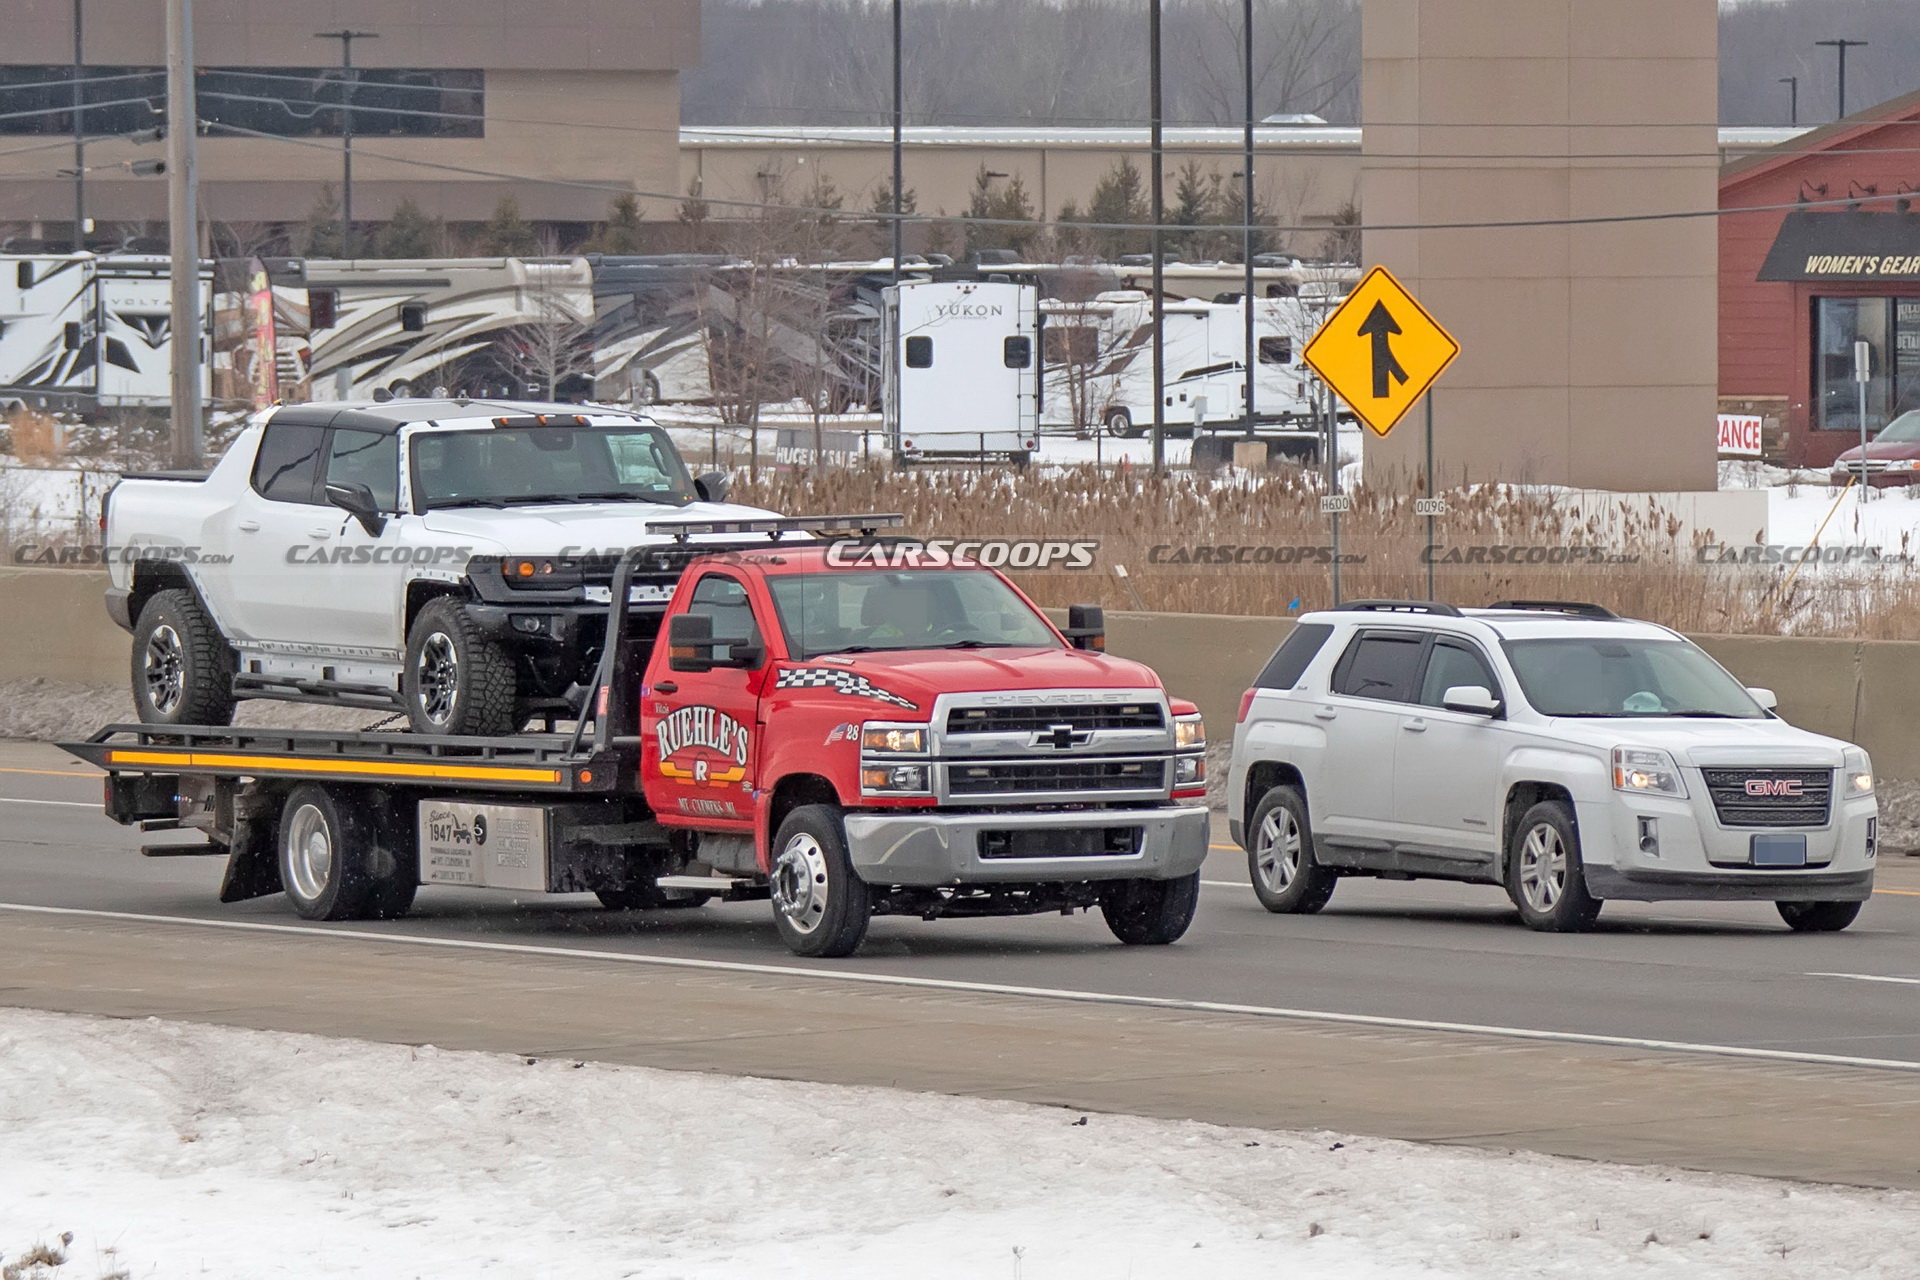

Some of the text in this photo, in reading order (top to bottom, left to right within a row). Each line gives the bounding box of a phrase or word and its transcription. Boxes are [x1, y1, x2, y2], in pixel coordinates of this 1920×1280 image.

[1805, 255, 1920, 275] WOMEN'S GEAR
[935, 304, 1003, 316] YUKON
[776, 446, 809, 466] HUGE
[827, 450, 859, 469] SALE
[1321, 497, 1349, 510] H600
[1416, 500, 1444, 513] 009G
[981, 693, 1132, 705] CHEVROLET
[656, 706, 748, 767] RUEHLE'S
[846, 723, 860, 741] 28
[695, 759, 708, 781] R
[1745, 779, 1803, 796] GMC
[429, 809, 451, 822] Since
[429, 823, 452, 842] 1947
